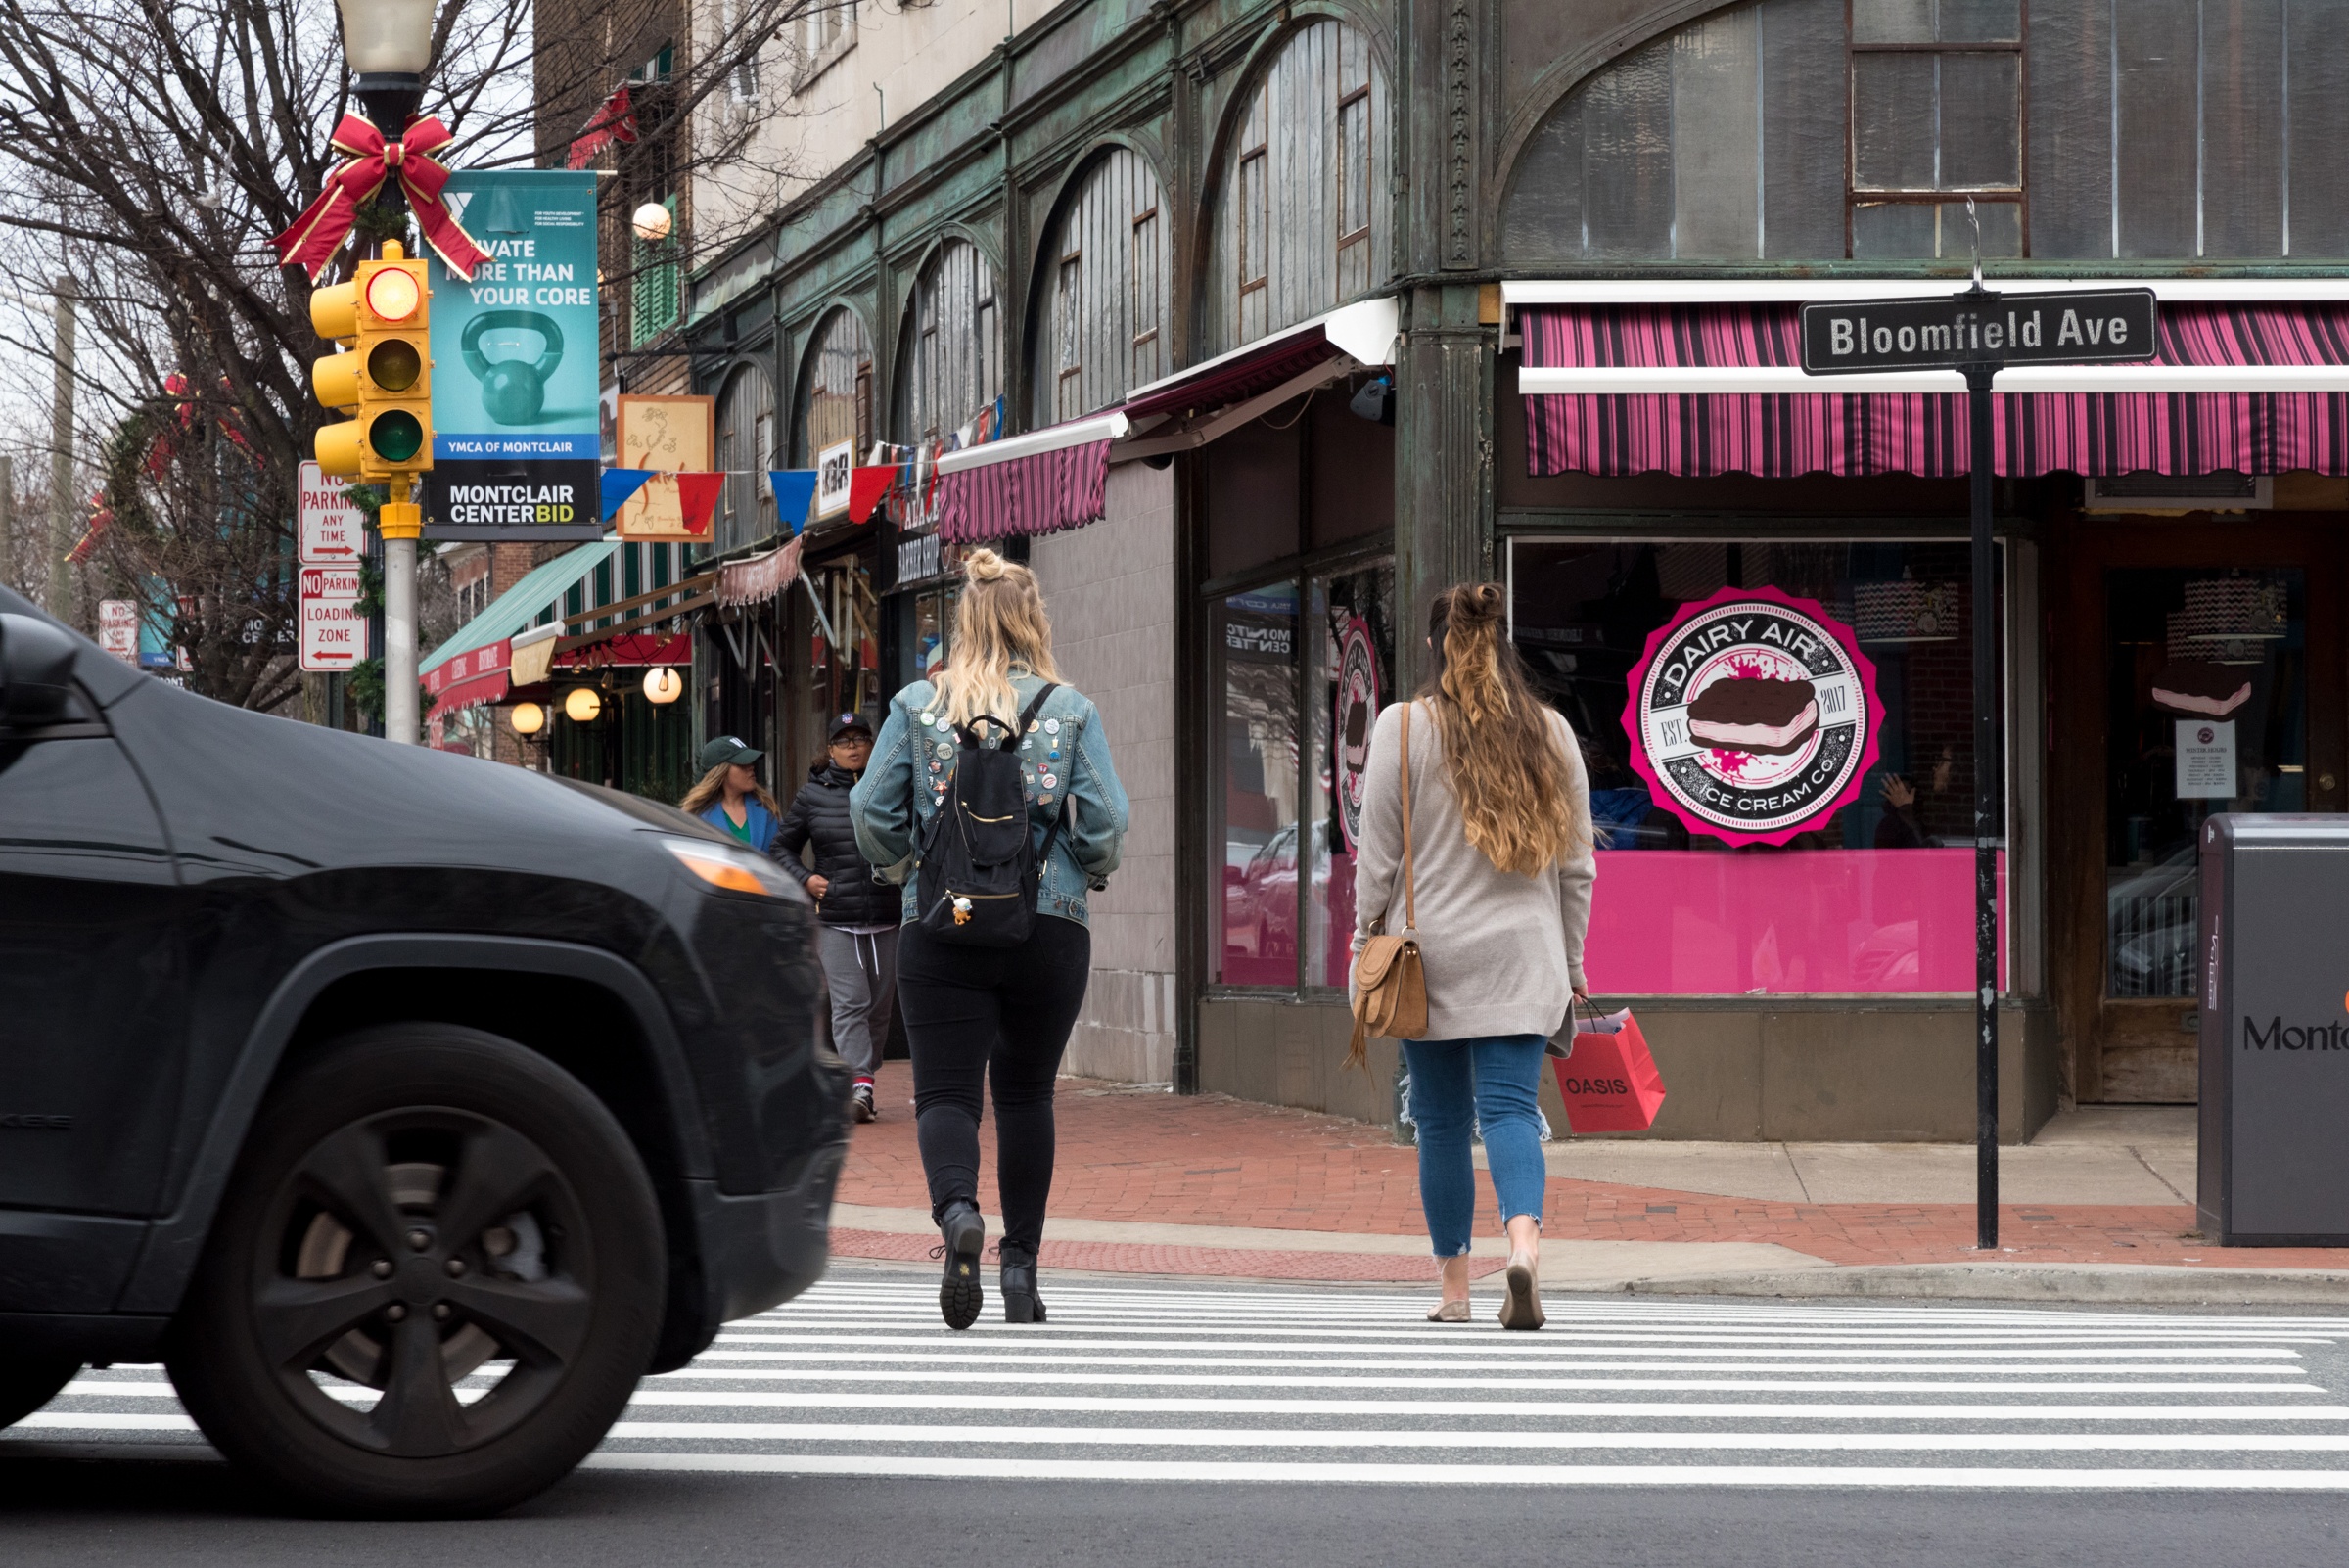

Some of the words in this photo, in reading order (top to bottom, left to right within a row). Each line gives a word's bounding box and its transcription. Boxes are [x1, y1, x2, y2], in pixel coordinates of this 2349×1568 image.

[513, 263, 574, 282] THAN
[469, 287, 529, 305] YOUR
[535, 287, 590, 305] CORE
[1830, 310, 2042, 355] Bloomfield
[2057, 308, 2128, 346] Ave
[448, 441, 483, 452] YMCA
[485, 441, 500, 452] OF
[503, 441, 573, 452] MONTCLAIR
[450, 485, 574, 504] MONTCLAIR
[322, 515, 344, 526] ANY
[320, 530, 345, 542] TIME
[898, 538, 922, 584] BARBER
[923, 532, 940, 577] SHOP
[302, 574, 322, 594] NO
[323, 577, 360, 591] PARKIN
[318, 629, 351, 642] ZONE
[1665, 619, 1754, 688] DAIRY
[1760, 622, 1818, 661] AIR
[1820, 685, 1846, 715] 2017
[1661, 718, 1688, 747] EST.
[1700, 784, 1733, 808] ICE
[1737, 782, 1812, 811] CREAM
[1566, 1078, 1628, 1095] OASIS
